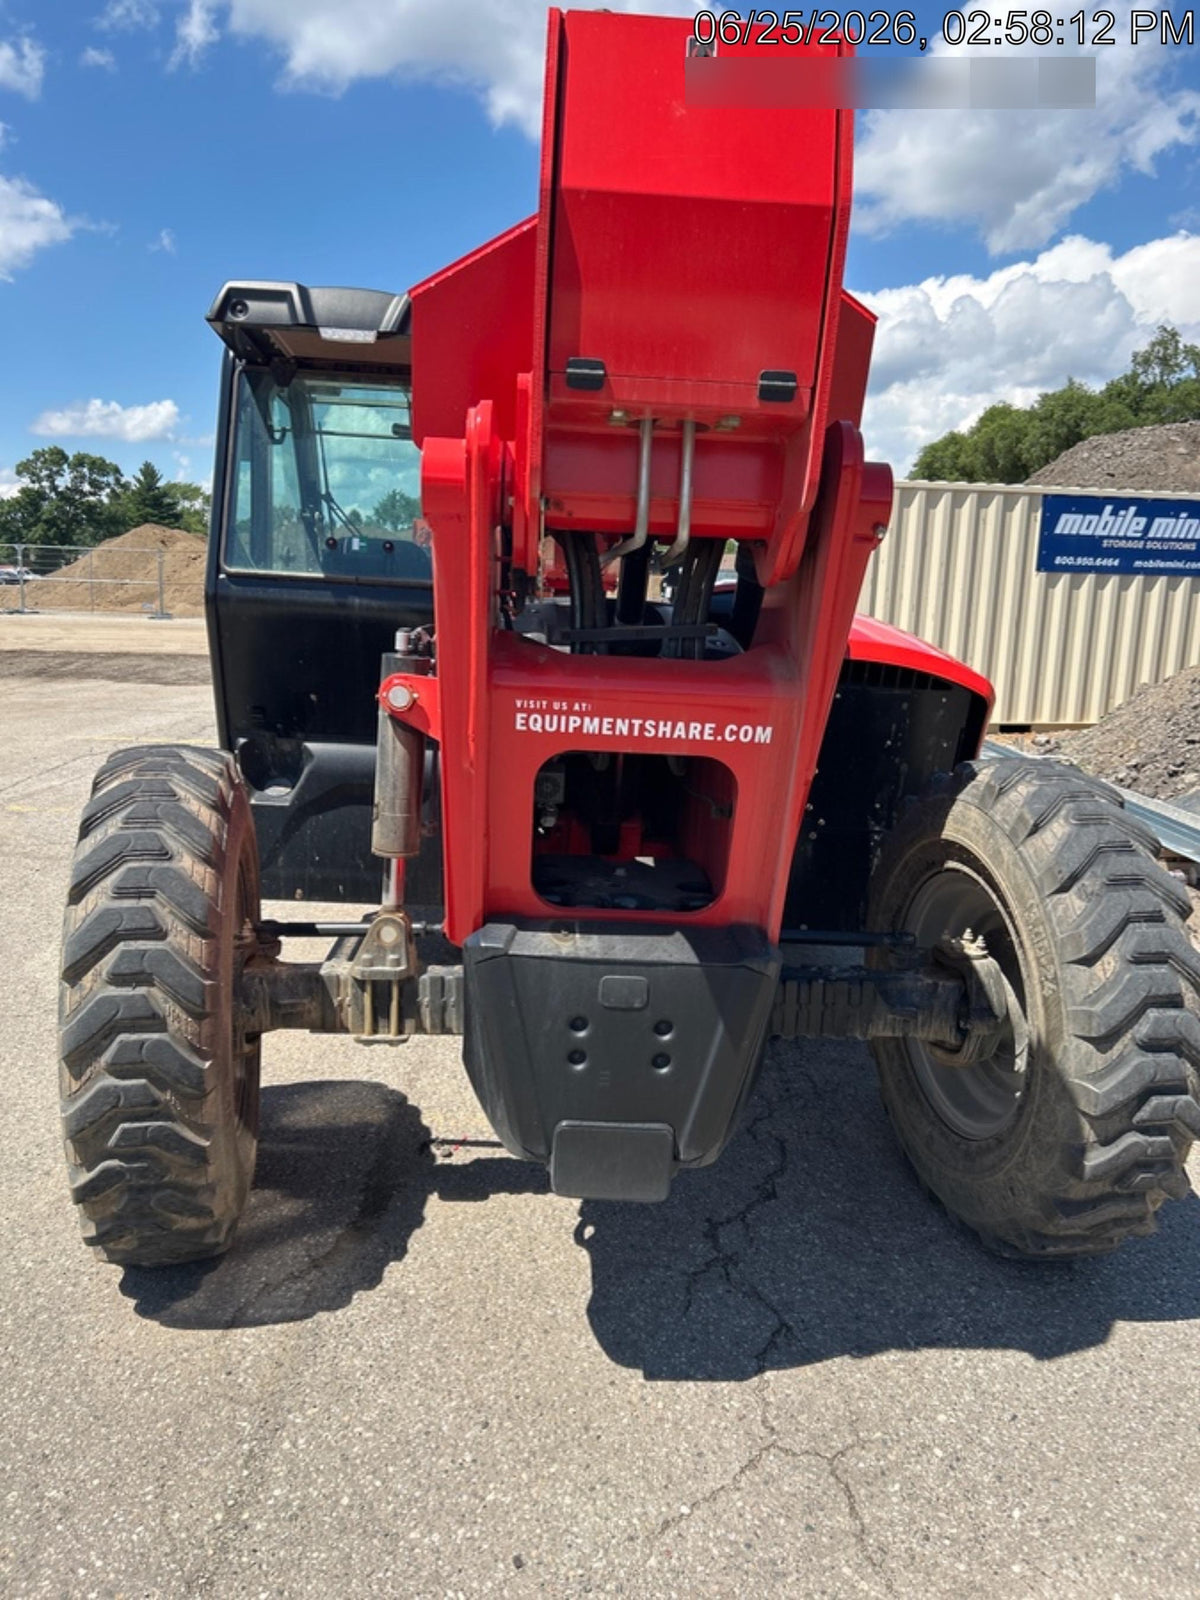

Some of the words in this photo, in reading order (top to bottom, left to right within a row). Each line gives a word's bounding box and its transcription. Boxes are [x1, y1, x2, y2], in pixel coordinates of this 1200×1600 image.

[1053, 504, 1148, 537] mobile
[1101, 539, 1145, 549] STORAGE
[1145, 540, 1197, 551] SOLUTIONS
[515, 699, 548, 709] VISIT
[553, 701, 568, 711] US
[515, 712, 773, 745] EQUIPMENTSHARE.COM
